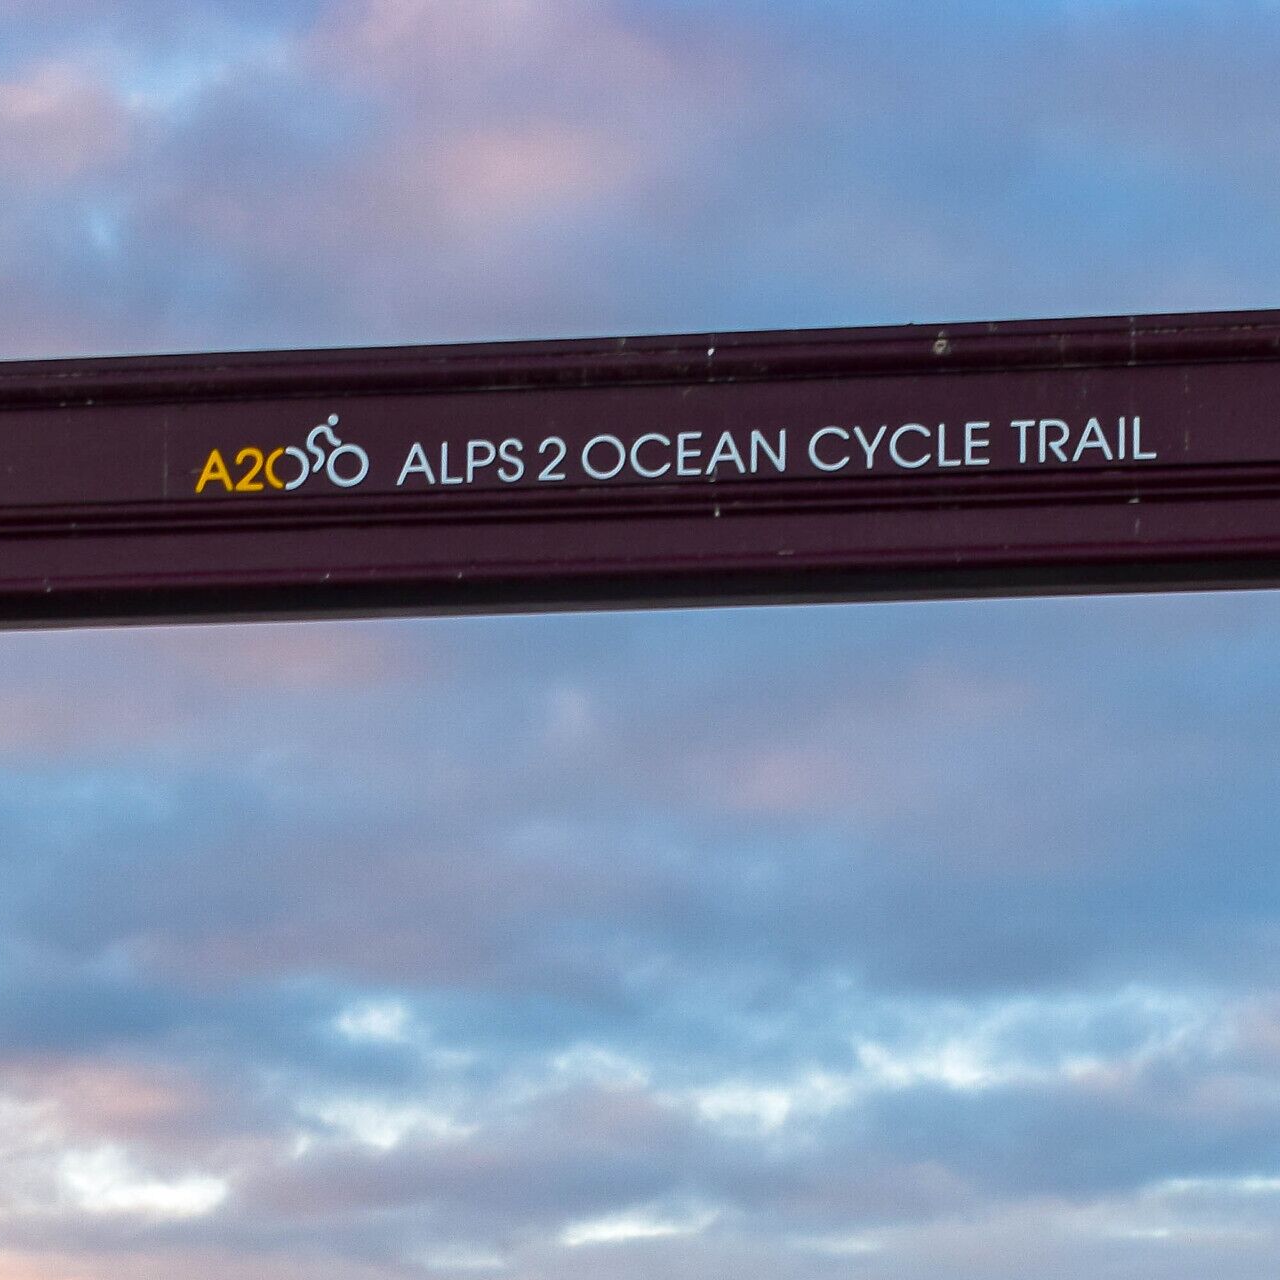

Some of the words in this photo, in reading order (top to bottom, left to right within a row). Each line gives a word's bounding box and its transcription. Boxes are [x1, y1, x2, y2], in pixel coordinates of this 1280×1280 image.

[397, 439, 525, 486] ALPS
[538, 436, 567, 481] 2
[582, 429, 787, 481] OCEAN
[808, 422, 991, 472] CYCLE
[1010, 416, 1158, 464] TRAIL
